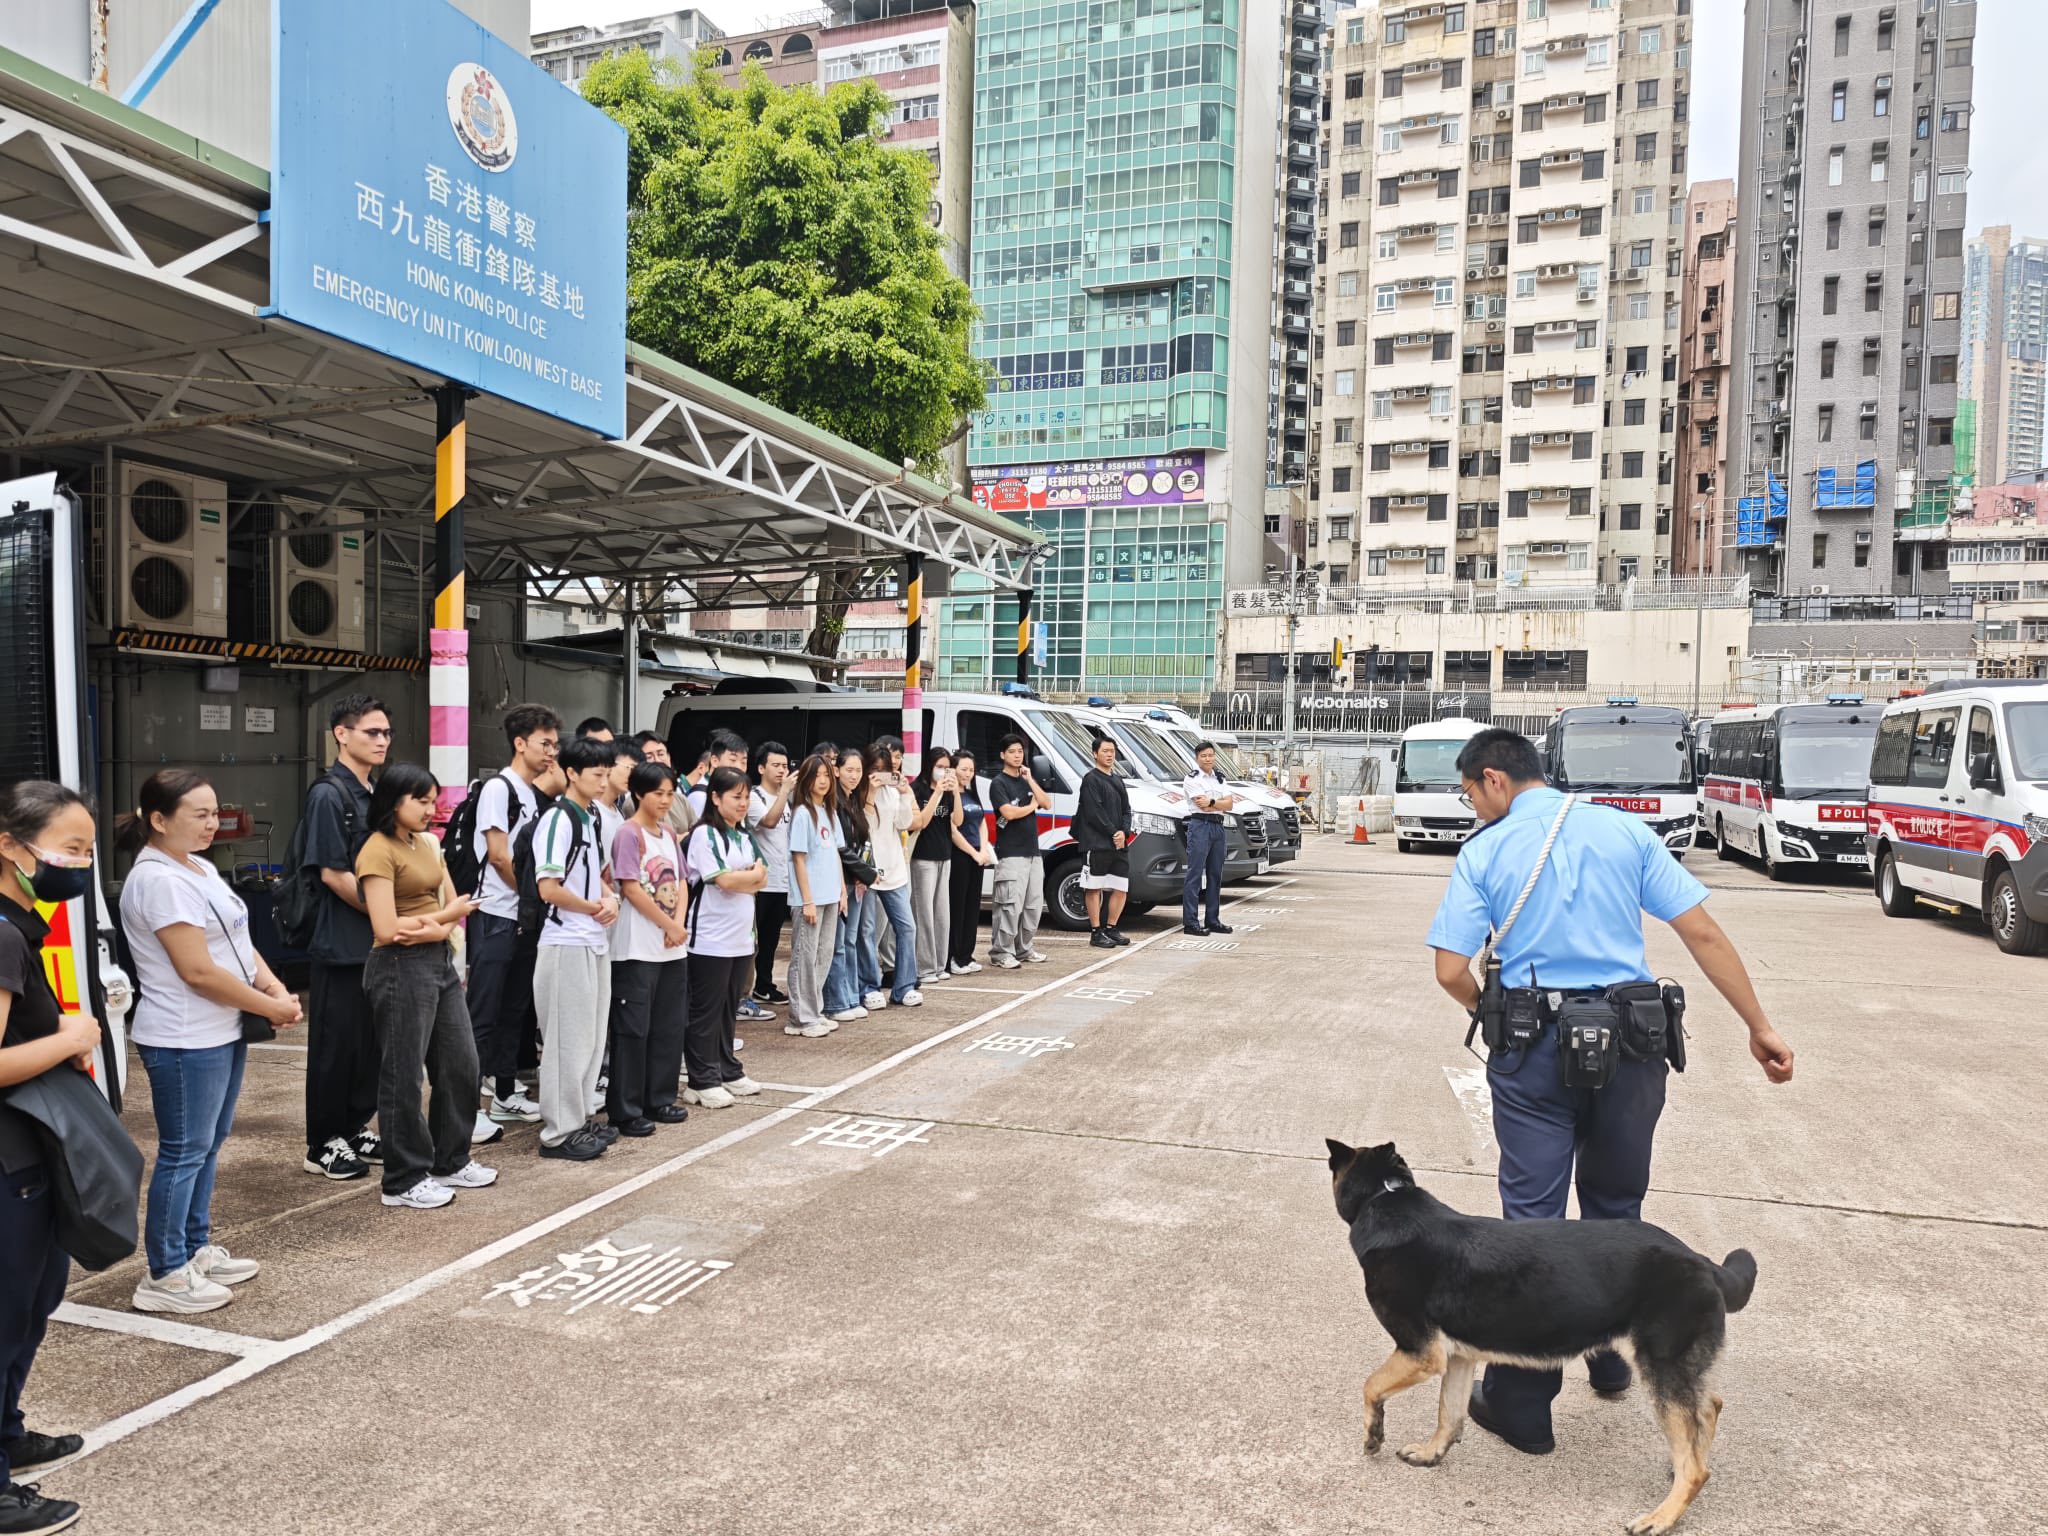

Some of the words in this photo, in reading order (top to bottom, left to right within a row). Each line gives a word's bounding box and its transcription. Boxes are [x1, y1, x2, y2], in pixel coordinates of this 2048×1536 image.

[424, 163, 537, 251] 香港警察
[354, 180, 585, 320] 西九龍衝鋒隊基地
[407, 261, 449, 298] HONG
[454, 276, 494, 316] KONG
[497, 302, 548, 340] POLICE
[313, 264, 420, 327] EMERGENCY
[423, 312, 462, 344] UNIT
[464, 323, 531, 373] KOWLOON
[535, 355, 568, 387] WEST
[571, 371, 603, 401] BASE
[1102, 366, 1165, 384] 語言學校
[1087, 485, 1122, 494] 31151180
[1300, 696, 1389, 709] McDonald's
[1916, 817, 1937, 836] POLICE
